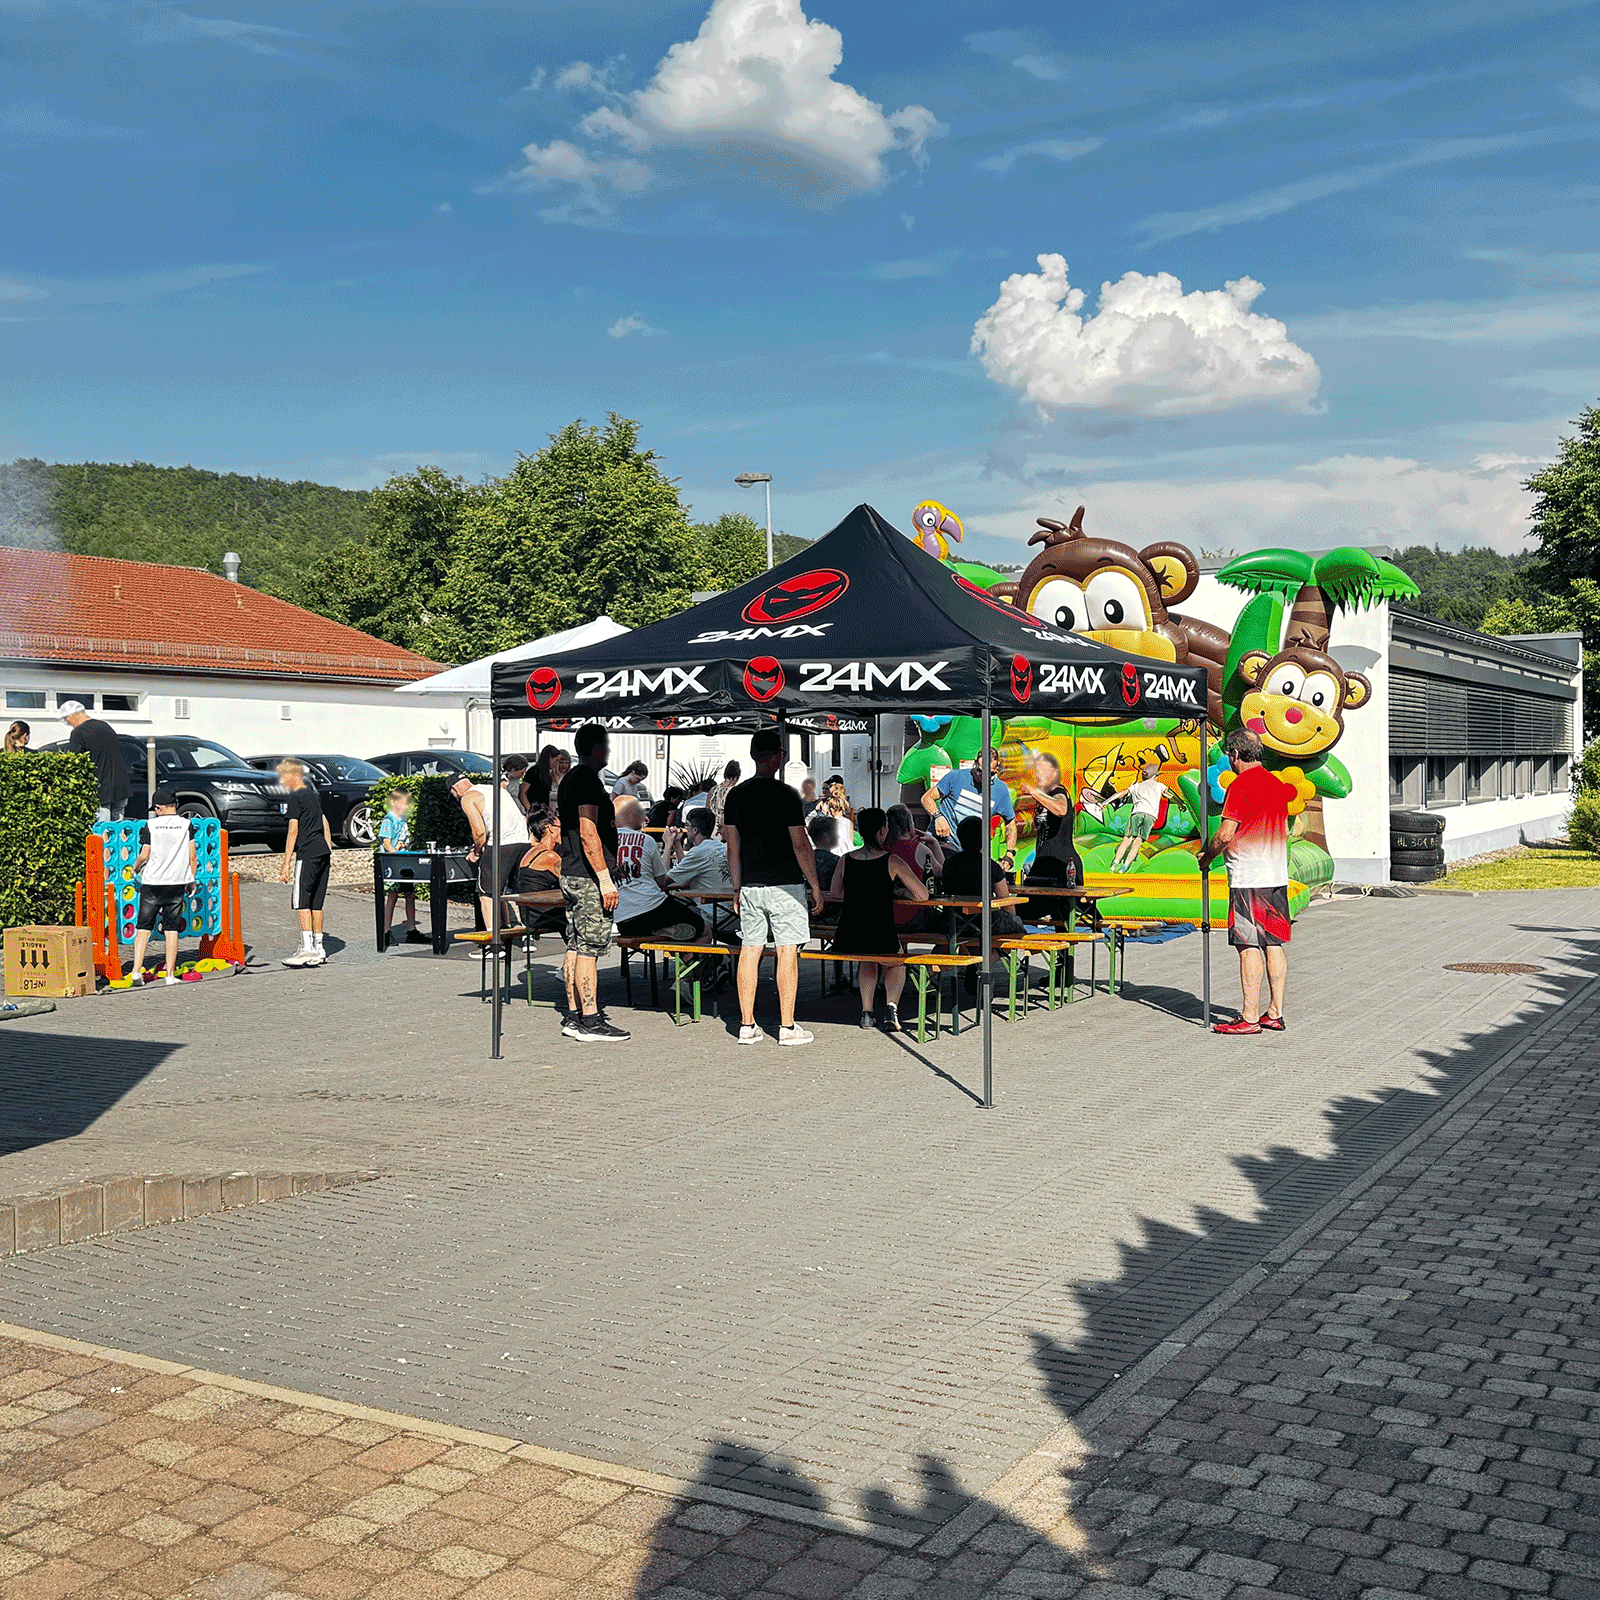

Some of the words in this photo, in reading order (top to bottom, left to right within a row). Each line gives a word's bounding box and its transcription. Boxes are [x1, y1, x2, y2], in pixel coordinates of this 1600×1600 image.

[687, 622, 834, 644] 24MX
[1020, 626, 1102, 650] 24MX
[574, 665, 710, 700] 24MX
[798, 660, 953, 692] 24MX
[1038, 663, 1107, 695] 24MX
[1143, 672, 1198, 705] 24MX
[838, 719, 869, 731] 24MX
